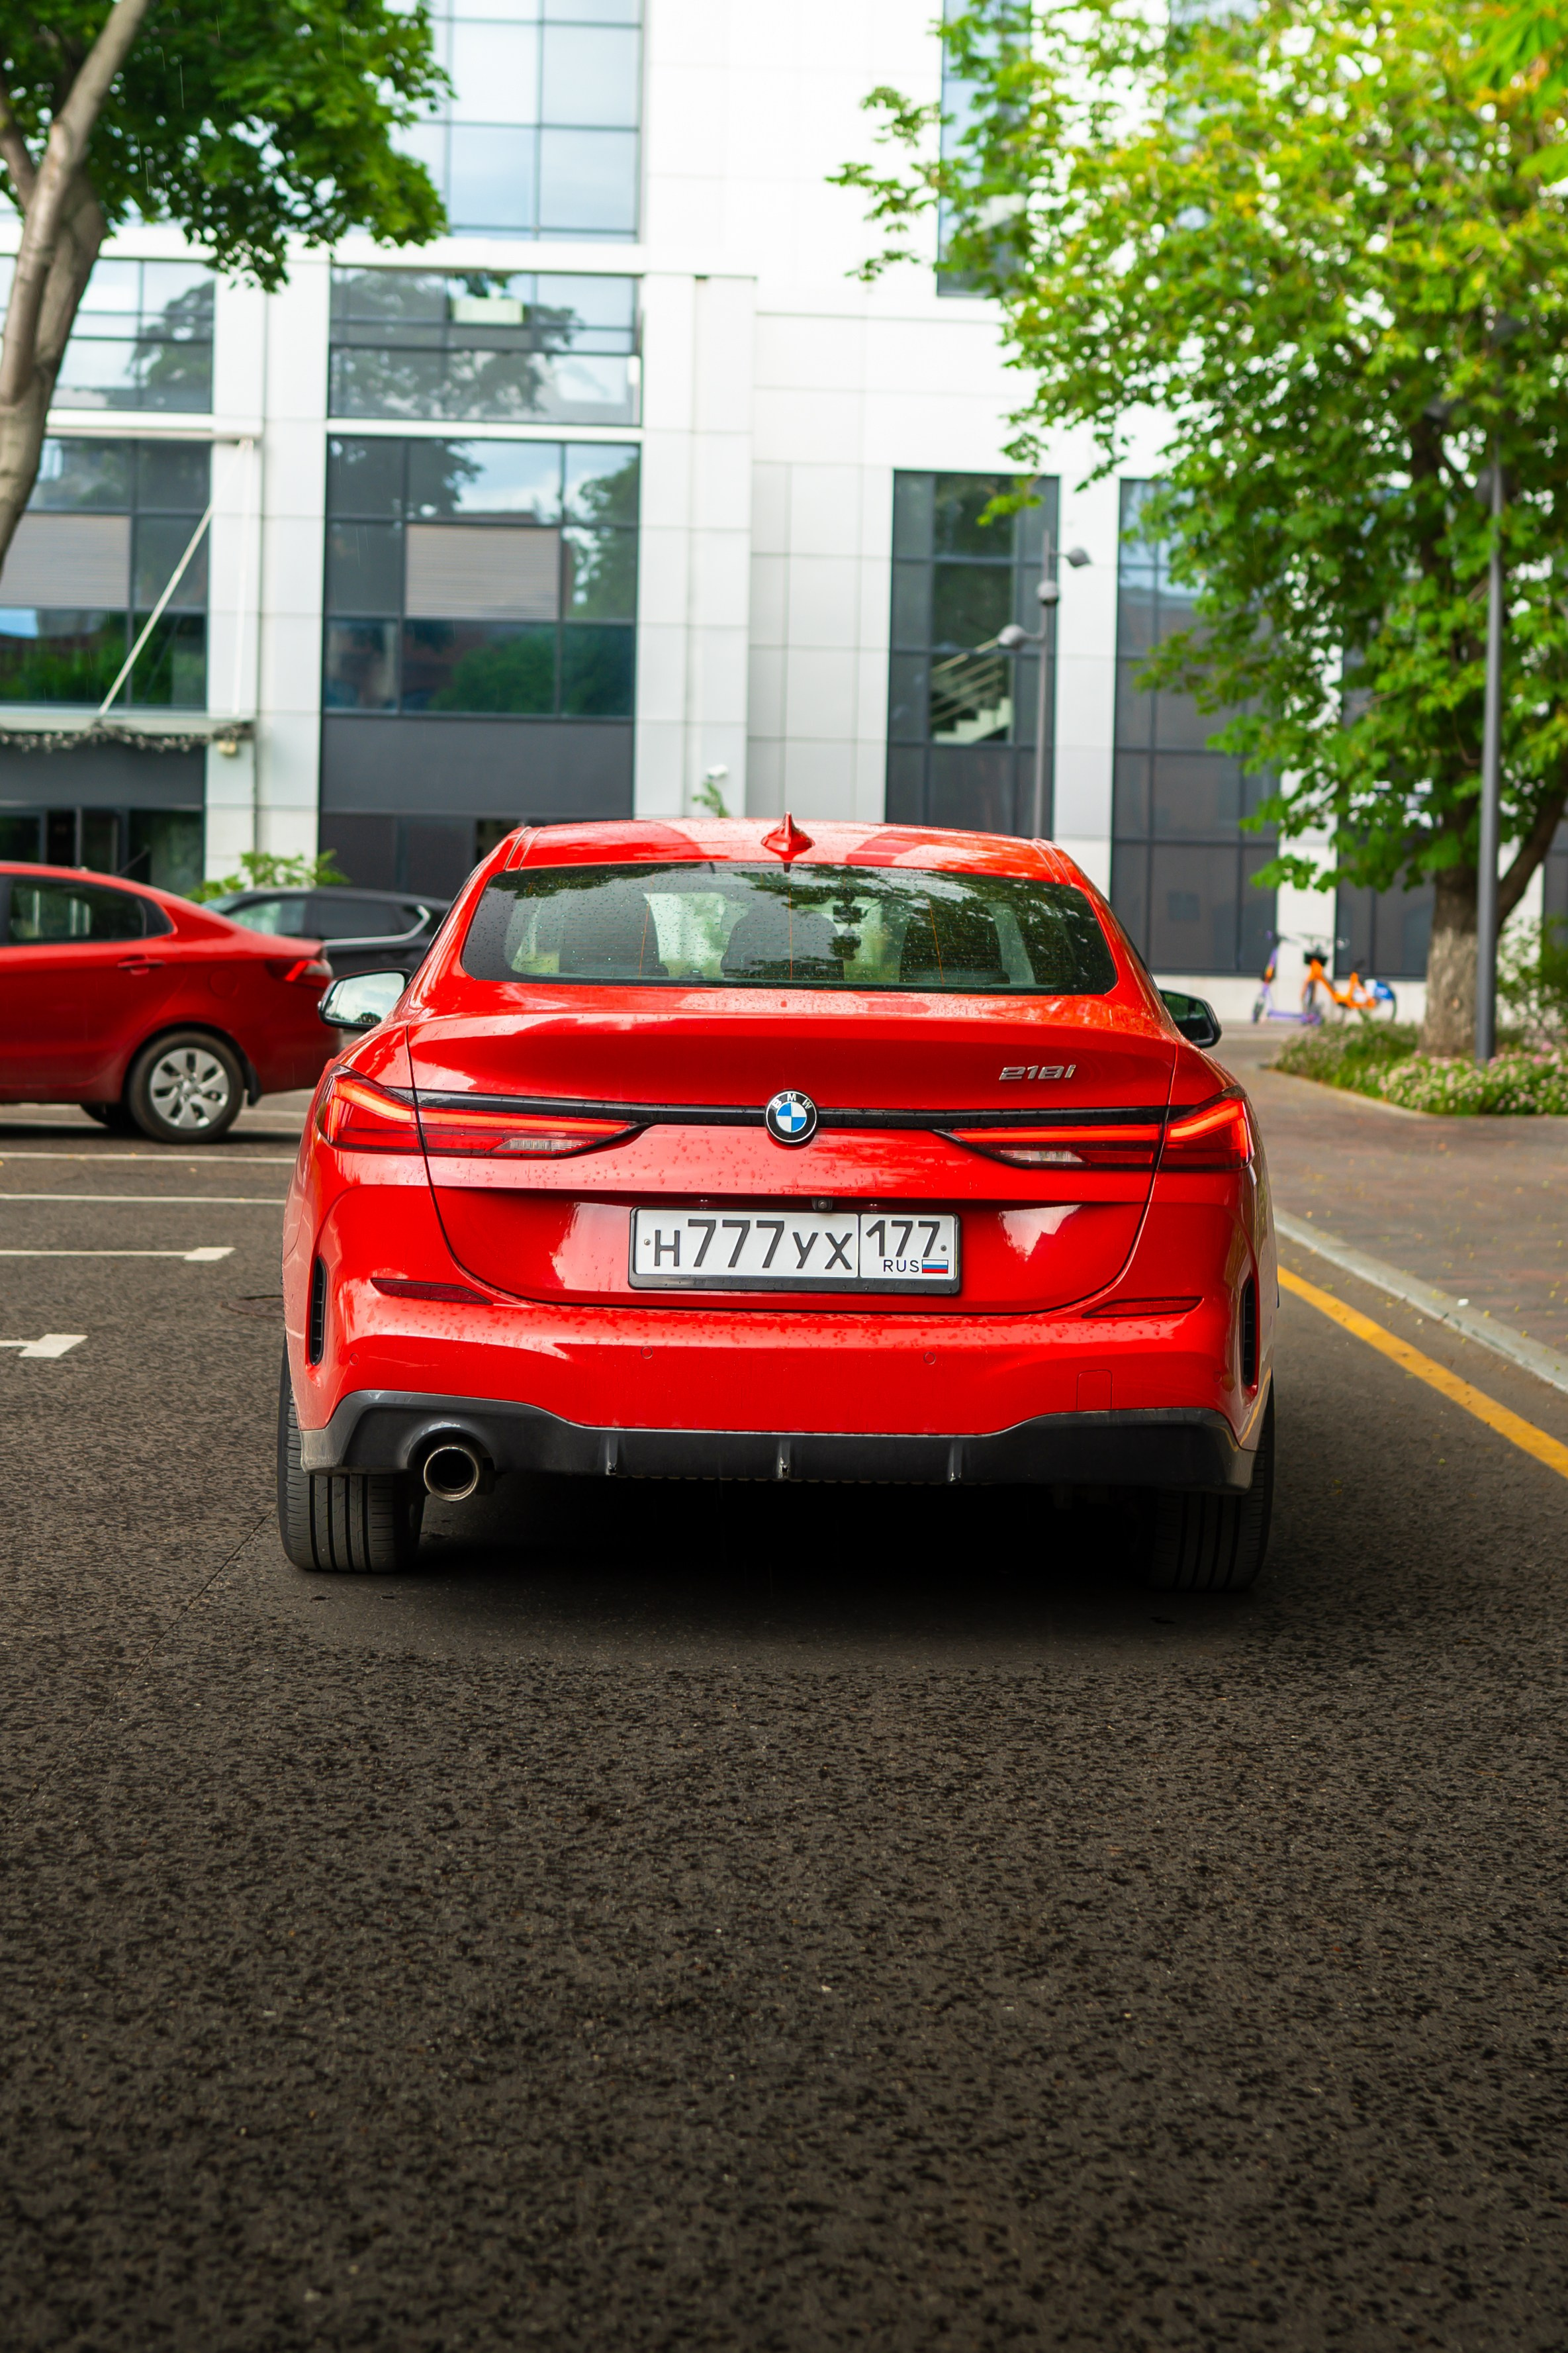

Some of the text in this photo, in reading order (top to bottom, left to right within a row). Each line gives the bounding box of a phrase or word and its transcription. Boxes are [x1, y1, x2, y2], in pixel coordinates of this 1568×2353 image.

[998, 1064, 1076, 1080] 218i
[772, 1093, 813, 1109] BMW
[866, 1220, 940, 1257] 177
[884, 1259, 919, 1273] RUS
